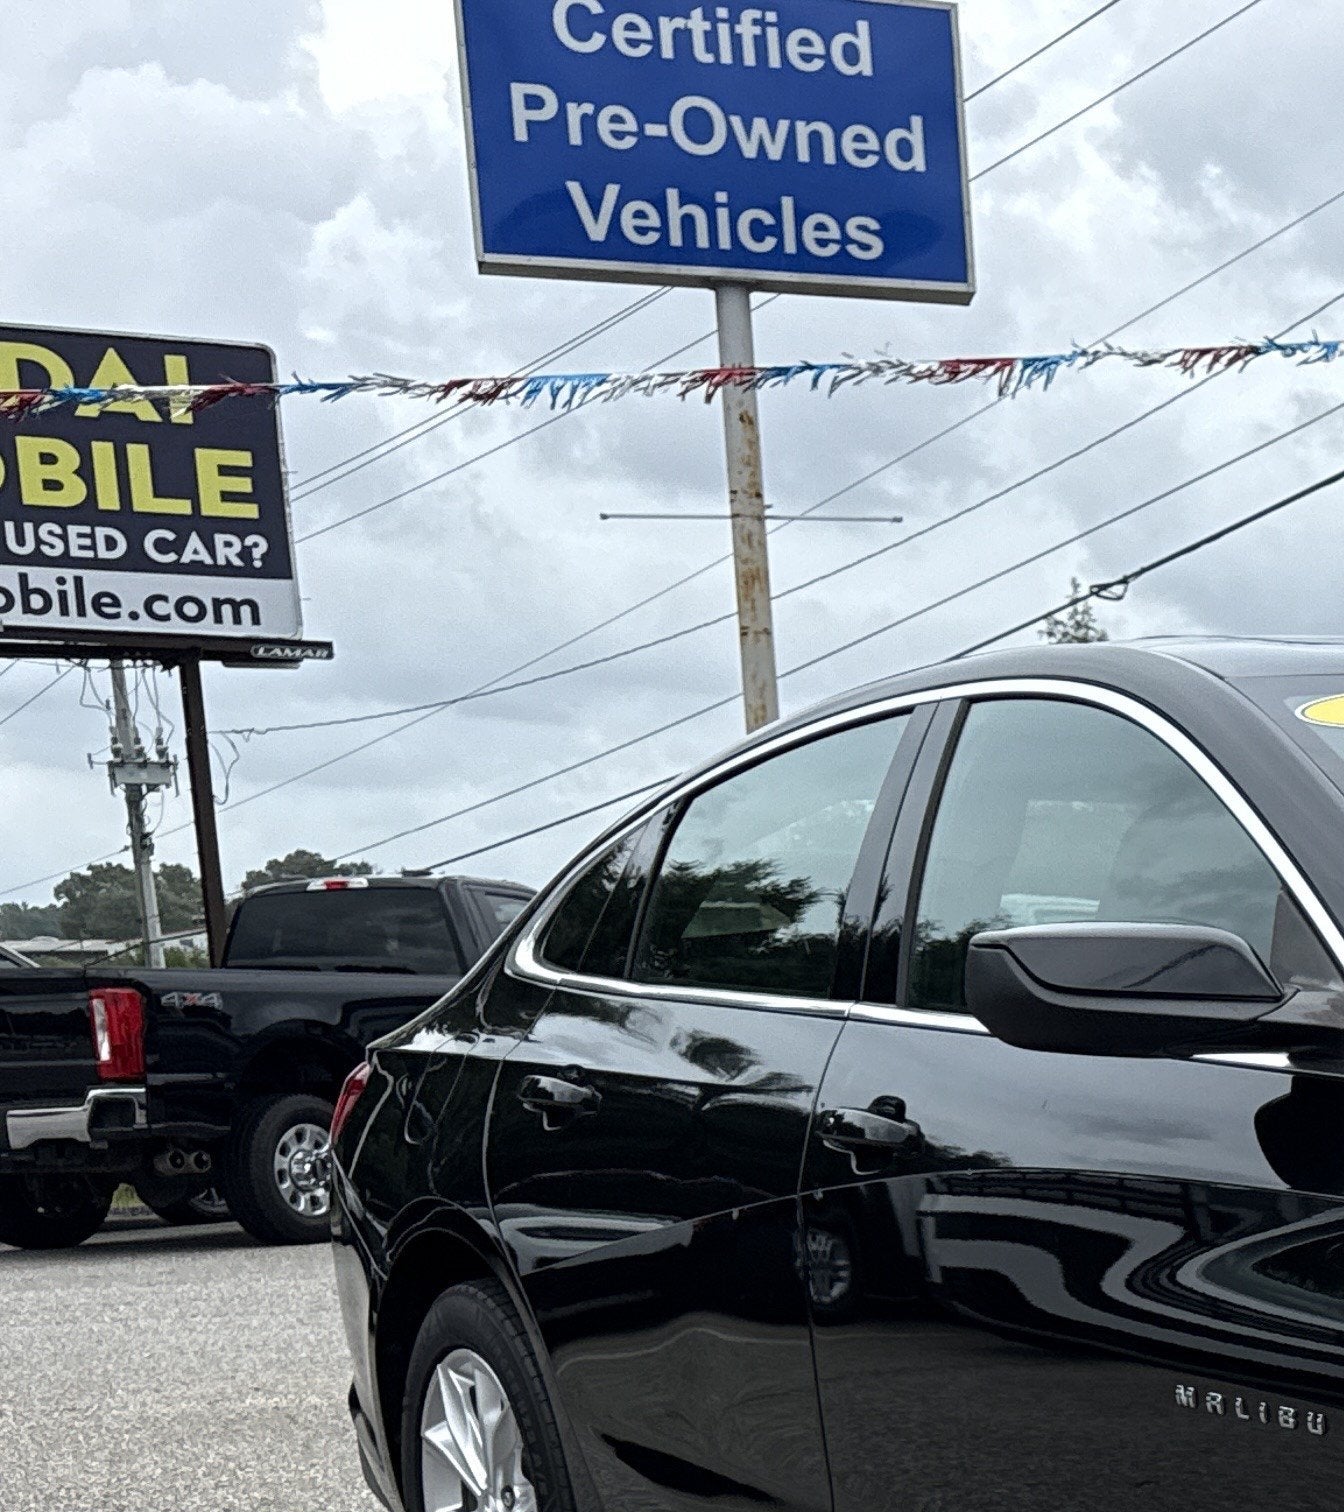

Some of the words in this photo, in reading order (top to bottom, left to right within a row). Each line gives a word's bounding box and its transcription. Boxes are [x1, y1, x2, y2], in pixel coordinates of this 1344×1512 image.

[552, 0, 874, 77] Certified
[510, 83, 927, 172] Pre-Owned
[565, 181, 884, 260] Vehicles
[0, 436, 259, 519] BILE
[5, 521, 127, 559] USED
[143, 529, 268, 568] CAR?
[257, 646, 328, 658] LAMAR
[1175, 1384, 1326, 1436] MALIBU
